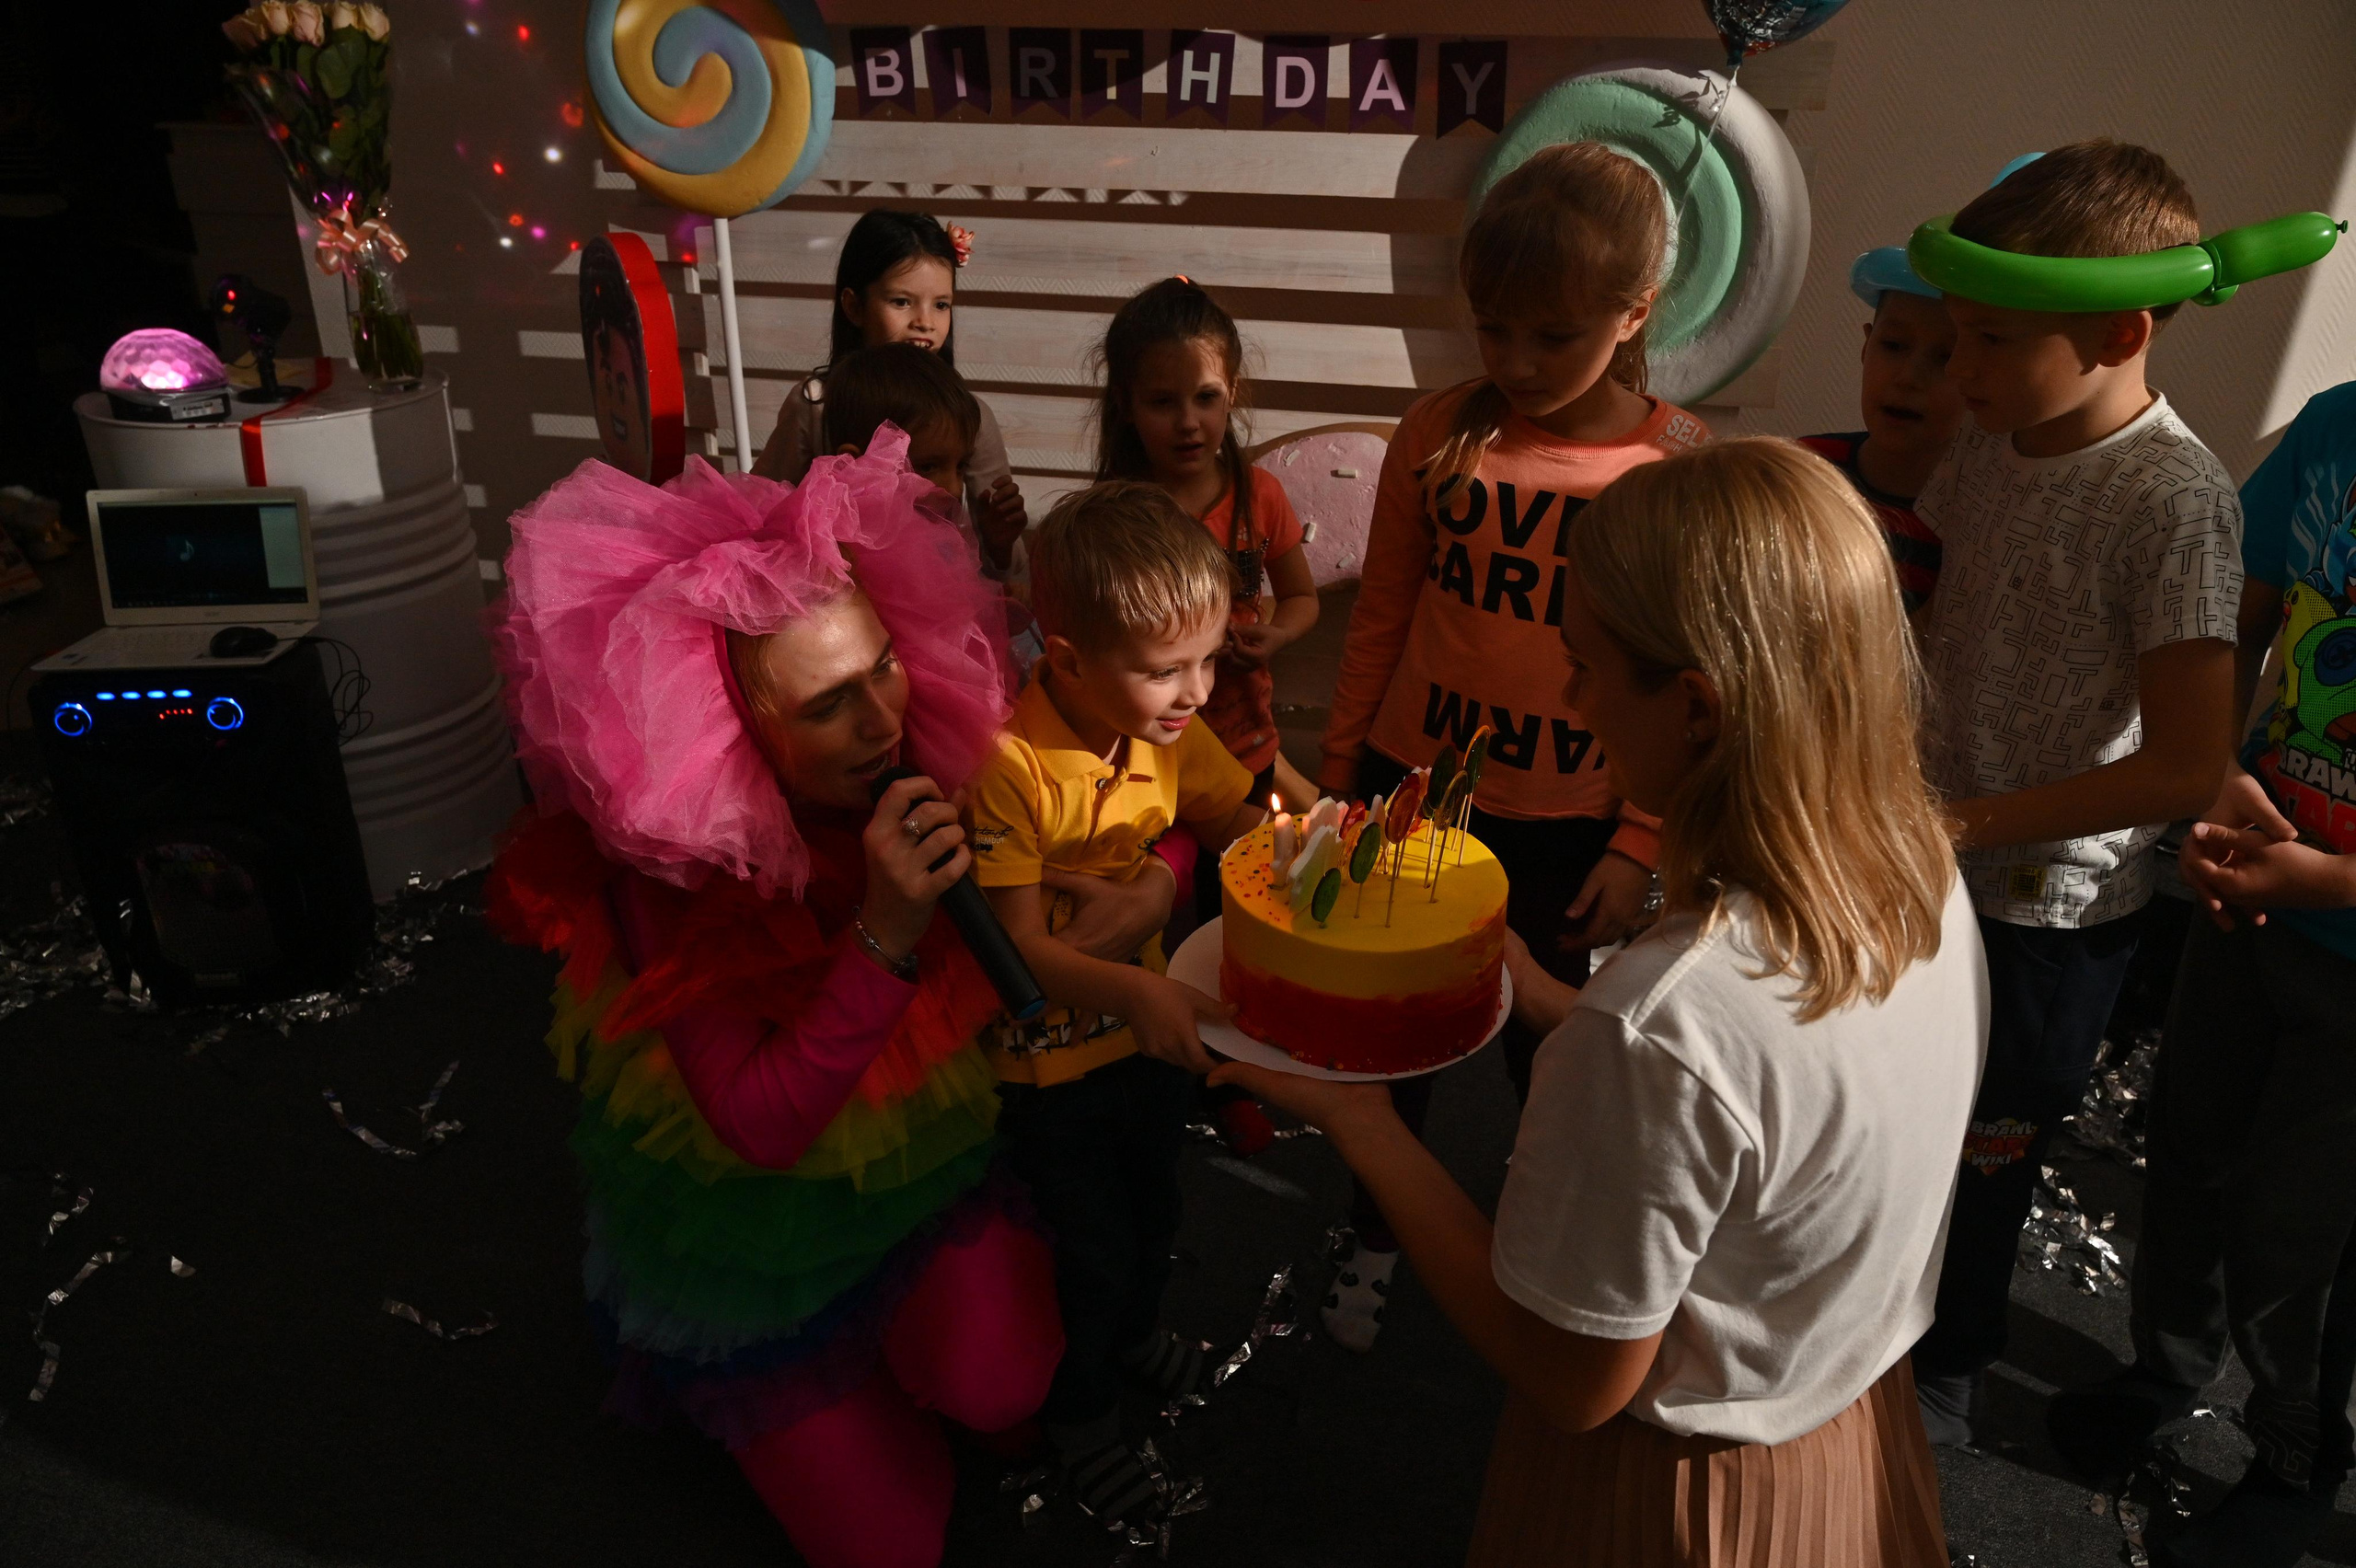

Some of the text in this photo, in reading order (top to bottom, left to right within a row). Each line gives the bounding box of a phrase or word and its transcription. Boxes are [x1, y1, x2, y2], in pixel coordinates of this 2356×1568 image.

[863, 46, 1496, 117] BIRTHDAY
[1414, 469, 1593, 559] OV
[1427, 539, 1566, 628] AR
[1423, 681, 1607, 774] ARM
[1970, 1120, 2034, 1137] BRAWL
[1971, 1153, 2013, 1167] WIKI
